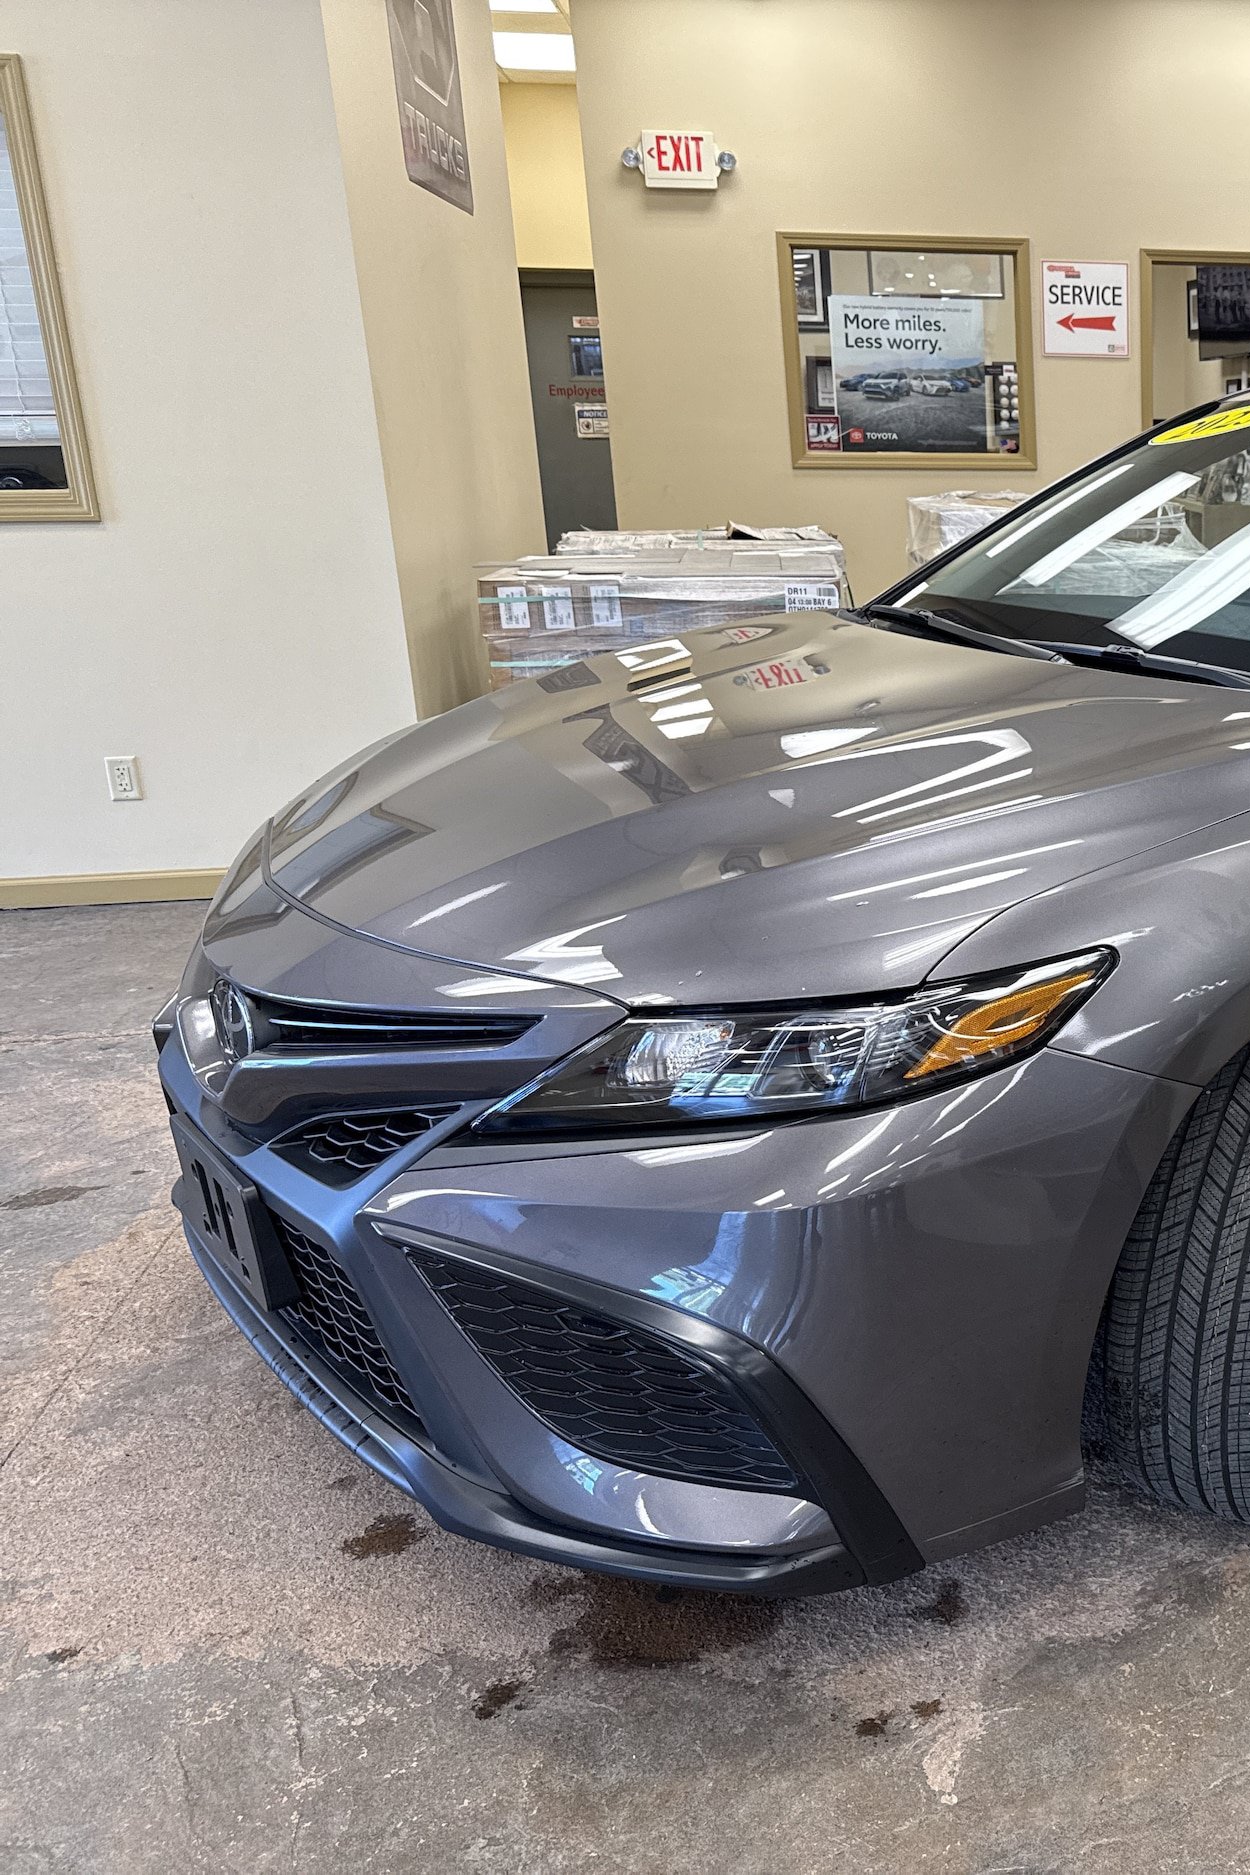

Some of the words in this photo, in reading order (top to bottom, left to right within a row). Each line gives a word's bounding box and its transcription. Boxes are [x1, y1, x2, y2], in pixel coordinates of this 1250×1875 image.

[404, 101, 466, 181] TRUCKS
[655, 135, 704, 172] EXIT
[1048, 284, 1122, 306] SERVICE
[844, 313, 890, 330] More
[895, 315, 946, 332] miles.
[844, 332, 882, 348] Less
[887, 337, 942, 355] worry.
[866, 432, 898, 440] TOYOTA
[788, 587, 807, 595] DR11
